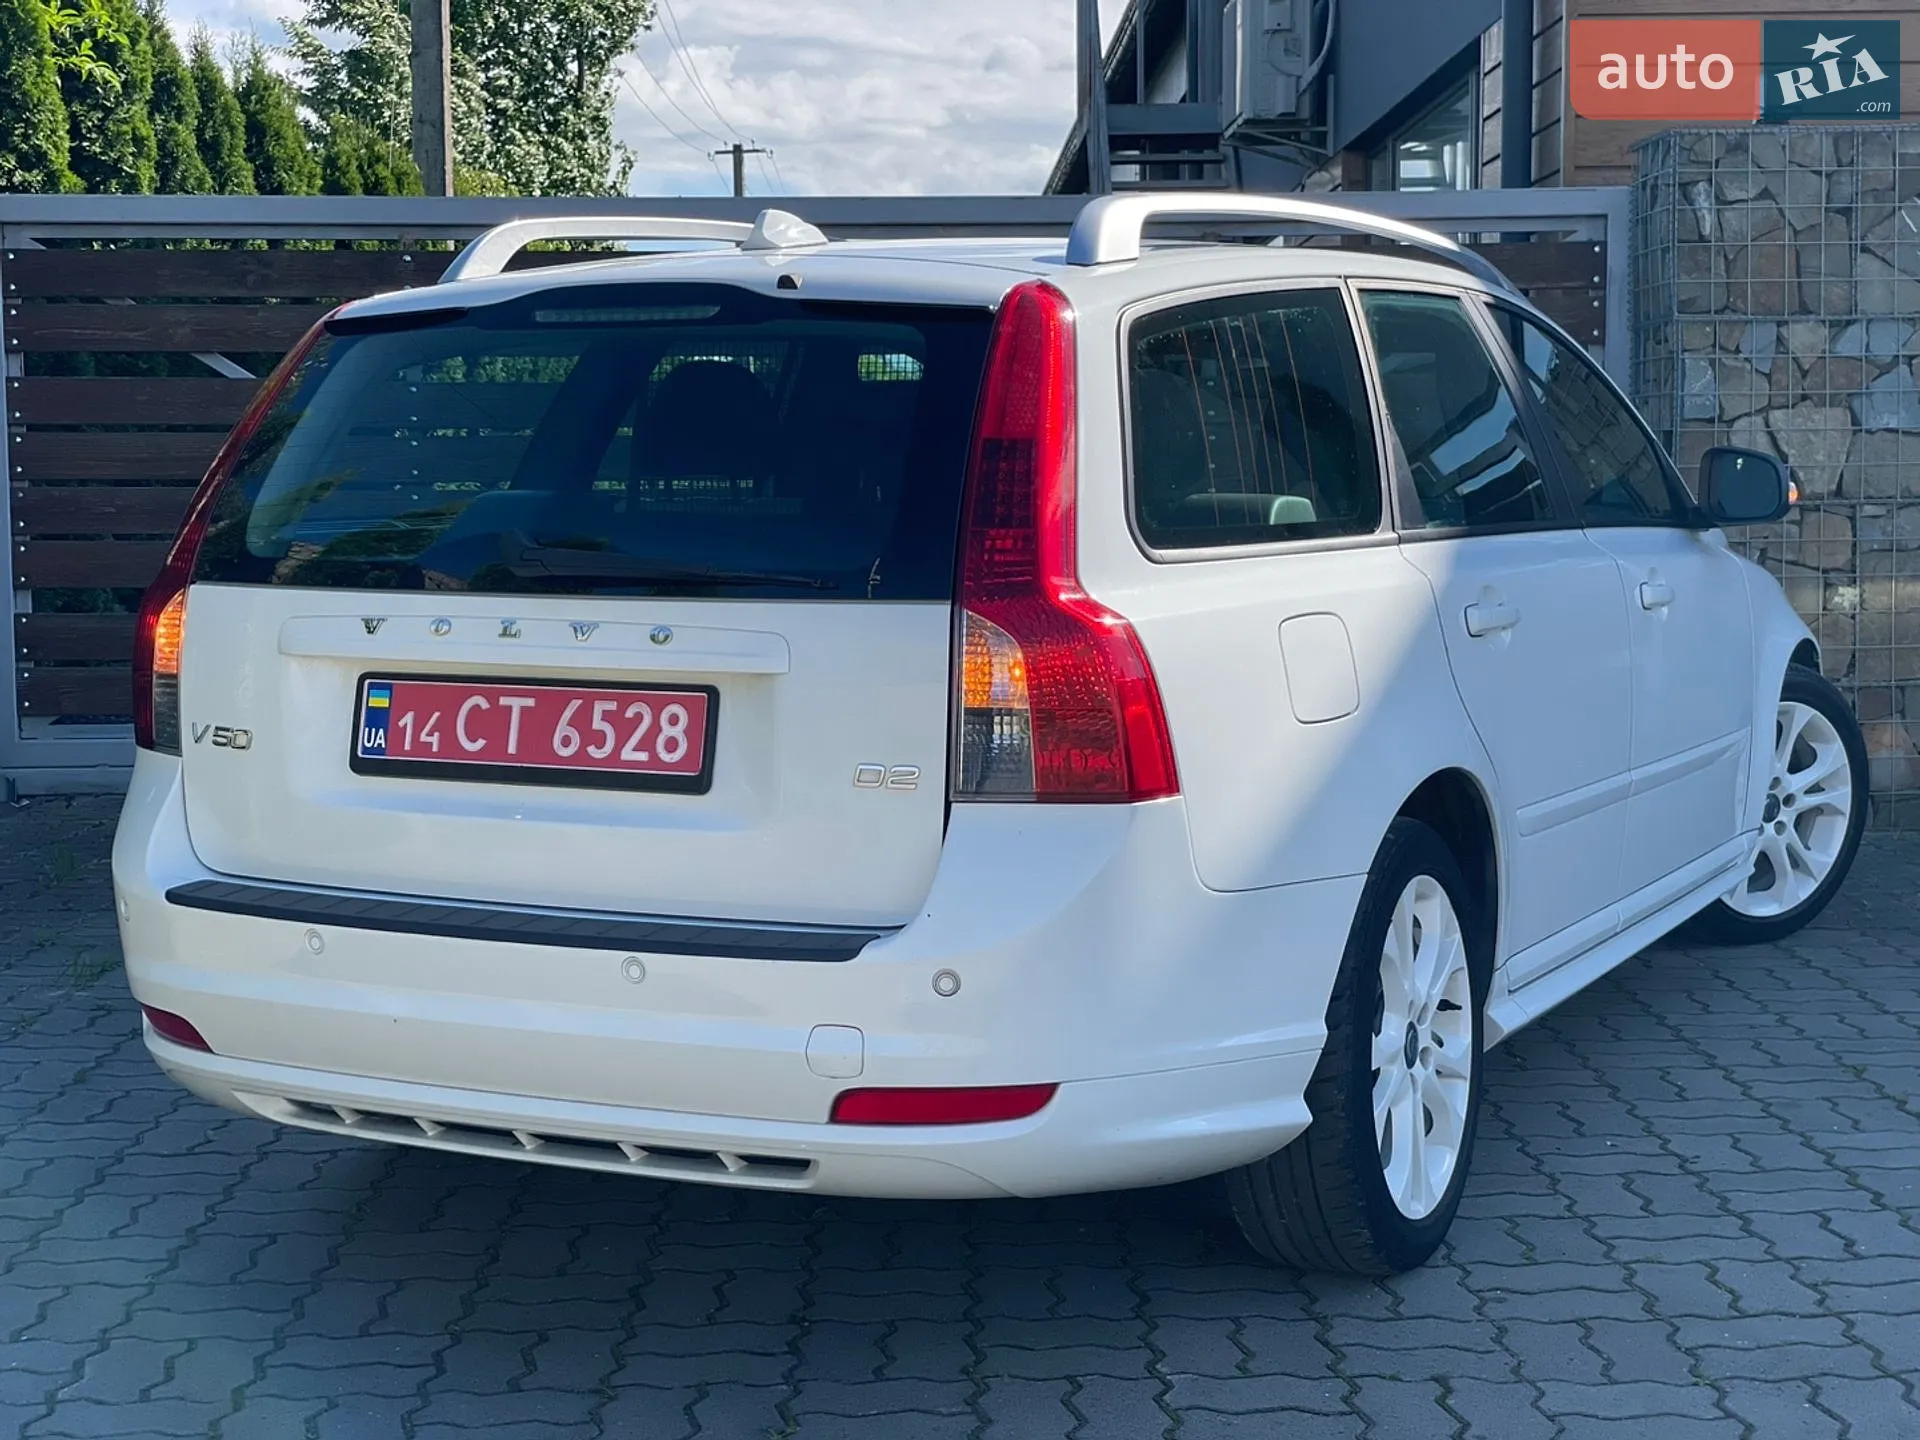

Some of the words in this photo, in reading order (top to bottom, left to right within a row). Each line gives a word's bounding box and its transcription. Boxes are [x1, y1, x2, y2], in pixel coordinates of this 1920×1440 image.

[361, 617, 674, 645] VOLVO
[192, 722, 253, 751] V50
[364, 727, 386, 748] UA
[398, 710, 442, 752] 14
[456, 695, 536, 755] CT
[552, 699, 689, 763] 6528
[853, 762, 921, 790] D2
